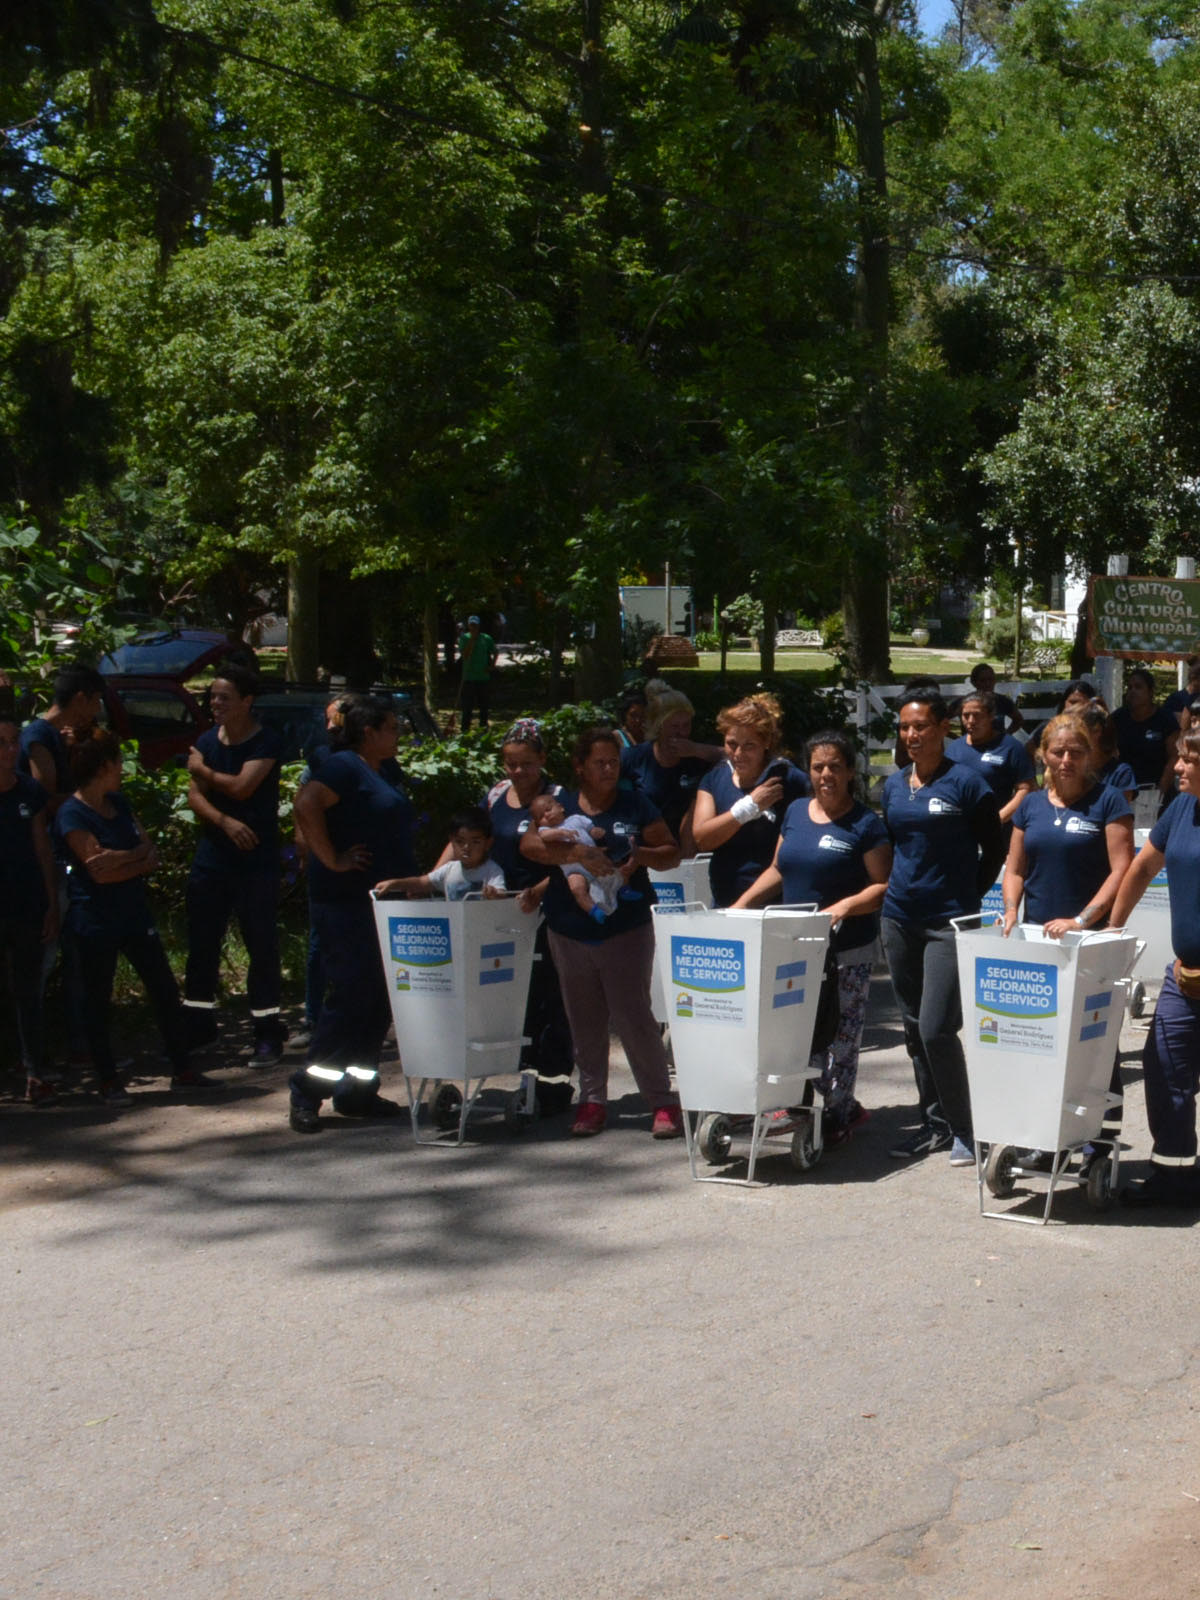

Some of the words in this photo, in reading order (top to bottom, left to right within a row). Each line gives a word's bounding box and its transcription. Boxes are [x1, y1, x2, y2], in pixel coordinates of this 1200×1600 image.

[1115, 583, 1185, 606] CENTRO
[1104, 600, 1199, 623] CULTURAL
[1100, 616, 1198, 636] MUNICIPAL
[397, 924, 442, 935] SEGUIMOS
[393, 934, 448, 946] MEJORANDO
[397, 945, 407, 955] EL
[408, 945, 447, 956] SERVICIO
[681, 943, 735, 959] SEGUIMOS
[675, 955, 741, 971] MEJORANDO
[679, 967, 691, 978] EL
[693, 968, 739, 983] SERVICIO
[987, 966, 1046, 983] SEGUIMOS
[980, 978, 1053, 996] MEJORANDO
[983, 990, 997, 1002] EL
[998, 991, 1050, 1008] SERVICIO
